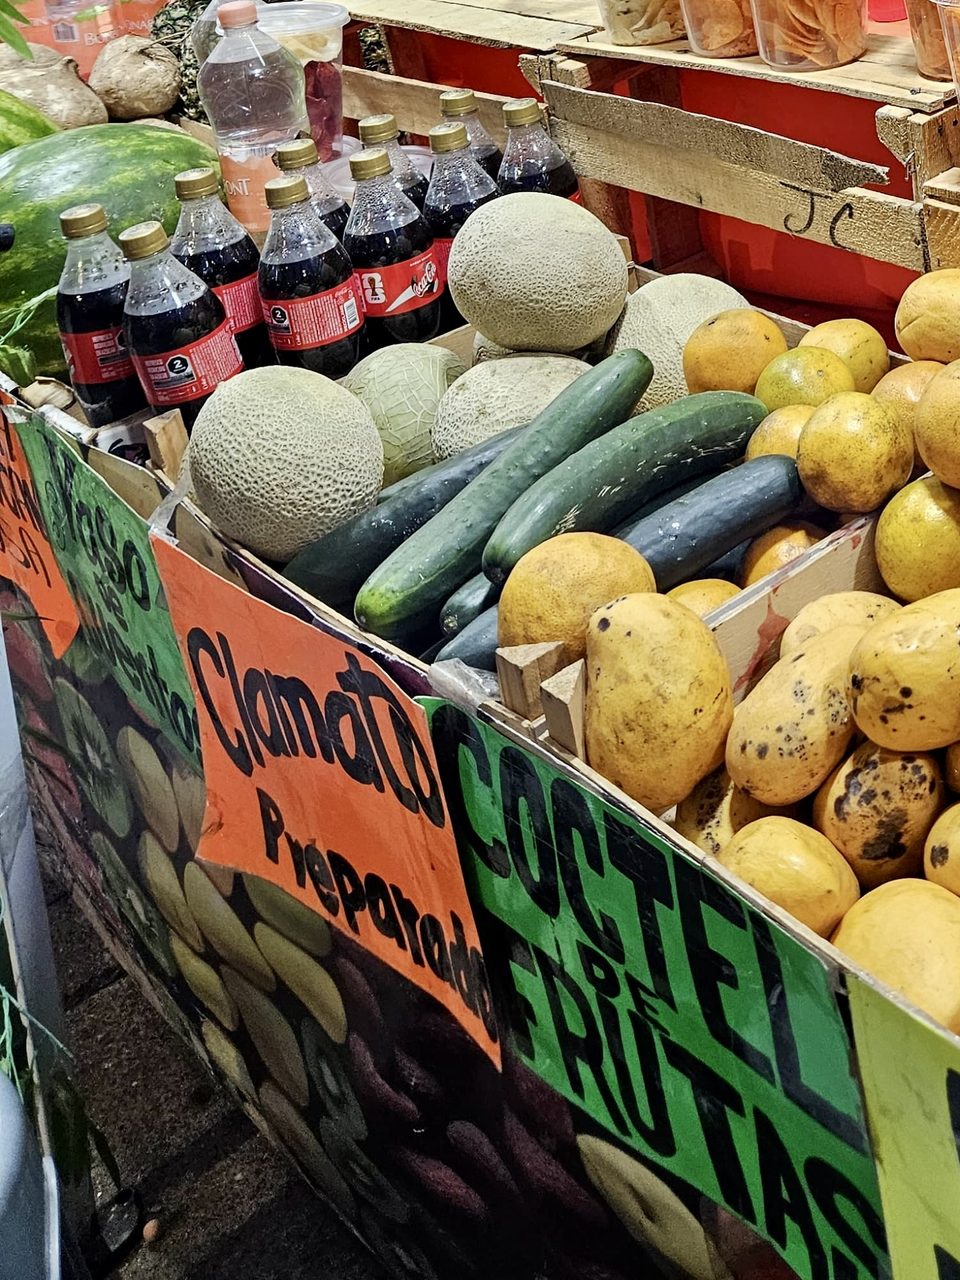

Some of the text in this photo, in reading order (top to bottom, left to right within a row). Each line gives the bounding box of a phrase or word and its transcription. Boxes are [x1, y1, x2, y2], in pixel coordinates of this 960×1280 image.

[173, 360, 183, 369] 2
[272, 310, 282, 318] 2
[187, 625, 447, 829] Clamato
[256, 787, 499, 1044] Preparado
[430, 703, 872, 1160] COCTEL
